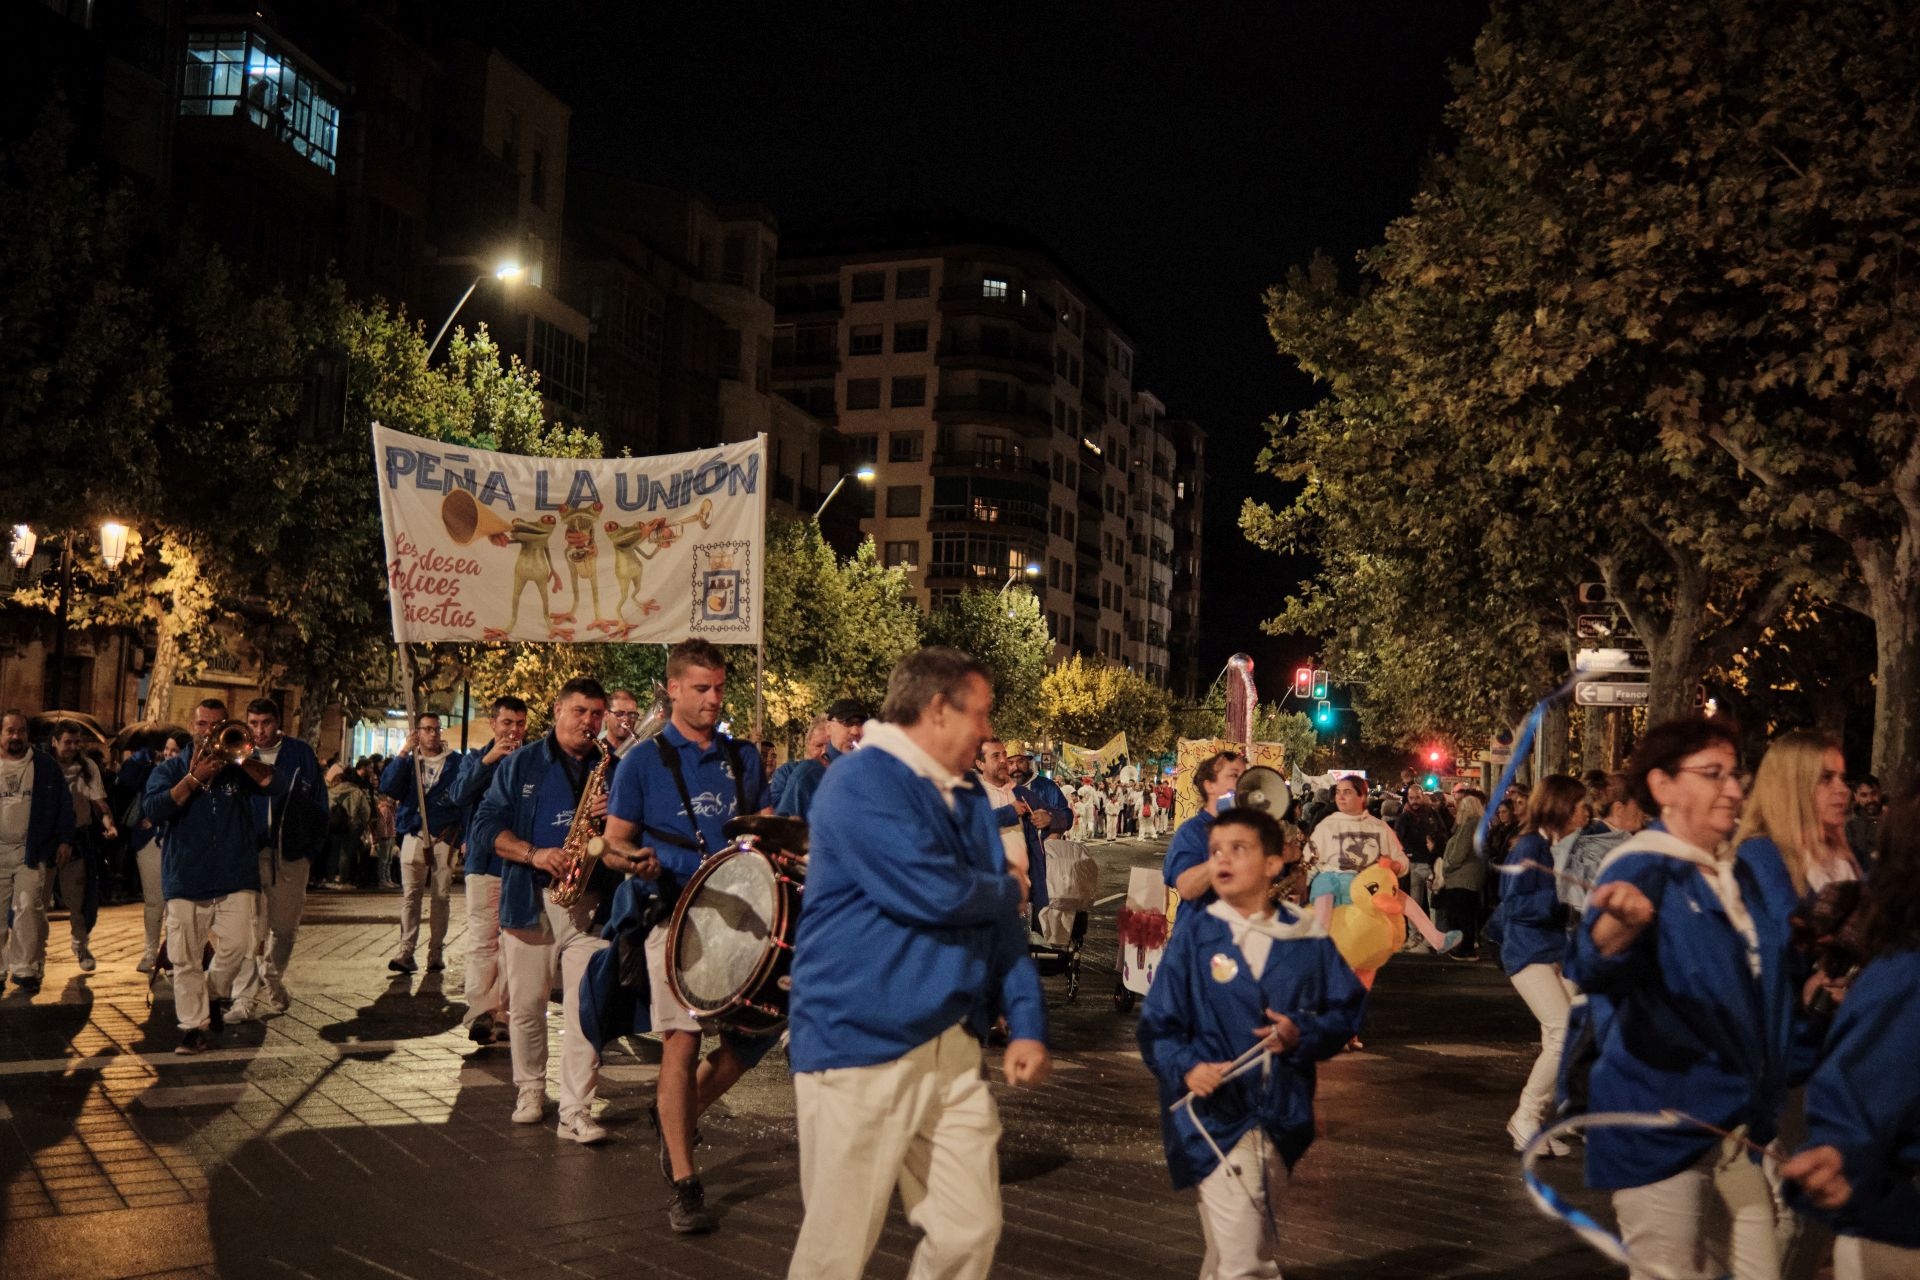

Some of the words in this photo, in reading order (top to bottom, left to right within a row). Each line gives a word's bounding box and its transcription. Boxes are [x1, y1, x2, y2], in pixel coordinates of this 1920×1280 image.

[385, 446, 516, 511] PEÑA
[535, 470, 601, 511] LA
[615, 452, 759, 512] UNIÓN
[420, 548, 482, 576] desea
[1615, 690, 1648, 698] Franco
